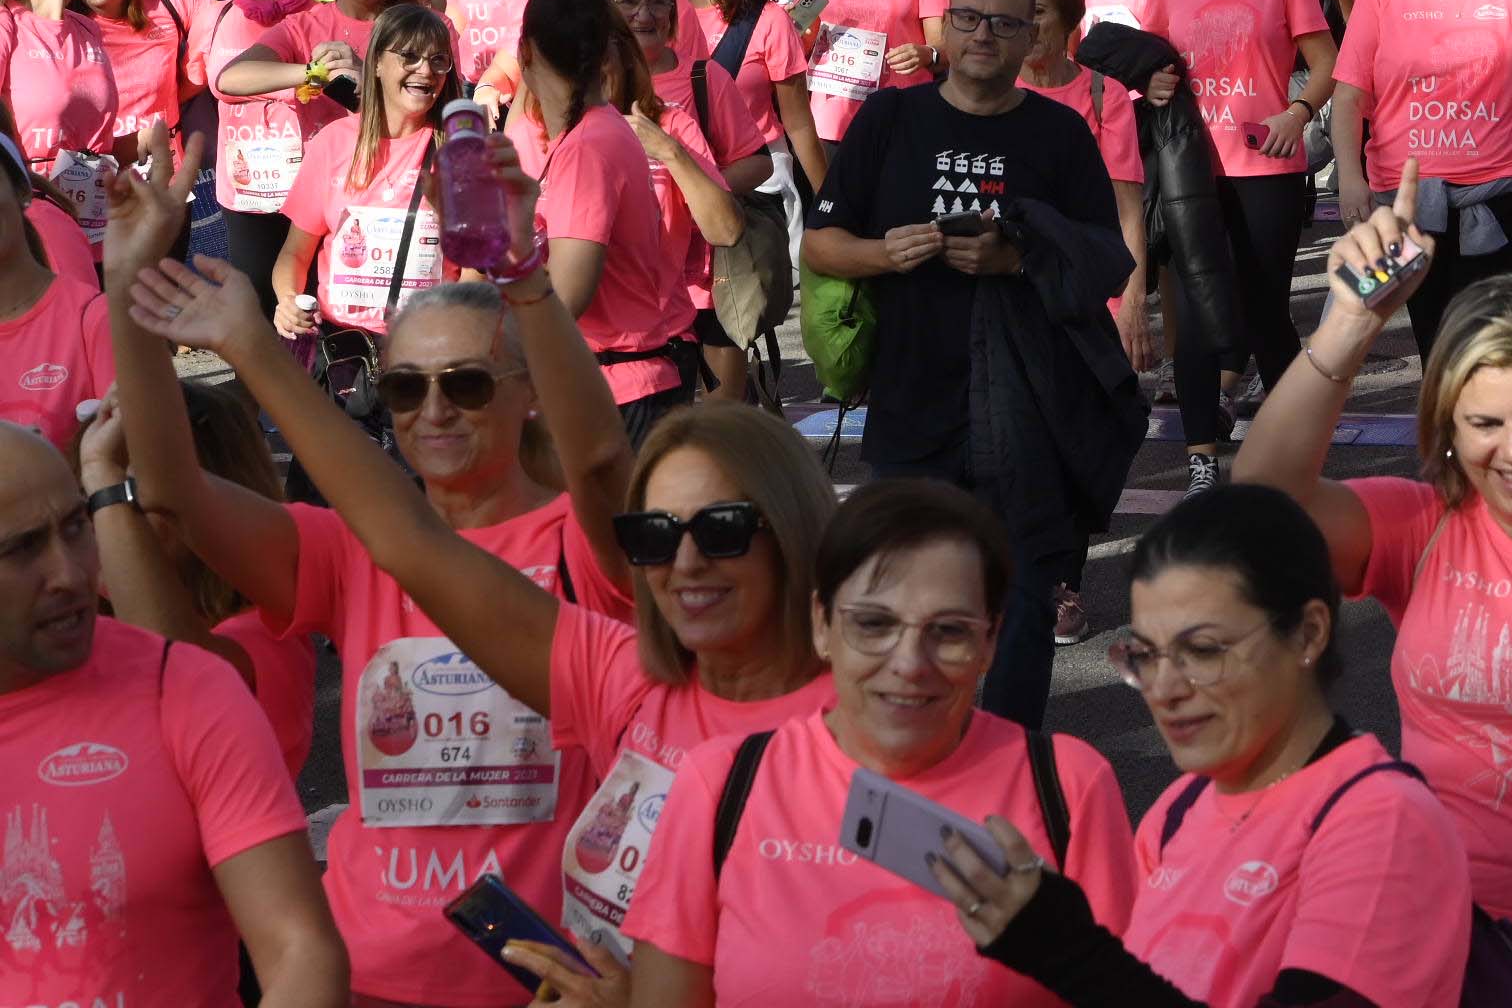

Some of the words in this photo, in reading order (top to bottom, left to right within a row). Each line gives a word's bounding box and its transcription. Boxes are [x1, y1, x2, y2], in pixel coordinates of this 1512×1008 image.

[467, 3, 489, 21] TU
[1403, 10, 1444, 22] OYSHO
[831, 52, 855, 66] 016
[1408, 75, 1436, 94] TU
[1409, 100, 1500, 122] DORSAL
[1407, 128, 1477, 149] SUMA
[252, 169, 281, 180] 016
[980, 179, 1006, 195] HH
[817, 199, 835, 214] HH
[371, 247, 394, 262] 01
[423, 711, 491, 738] 016
[440, 746, 471, 763] 674
[45, 757, 124, 779] ASTURIANA
[382, 772, 434, 784] CARRERA
[434, 772, 449, 783] DE
[451, 772, 466, 782] LA
[469, 771, 510, 781] MUJER
[377, 798, 433, 814] OYSHO
[482, 795, 542, 809] Santander
[758, 837, 860, 868] OYSHO
[375, 846, 505, 891] UMA
